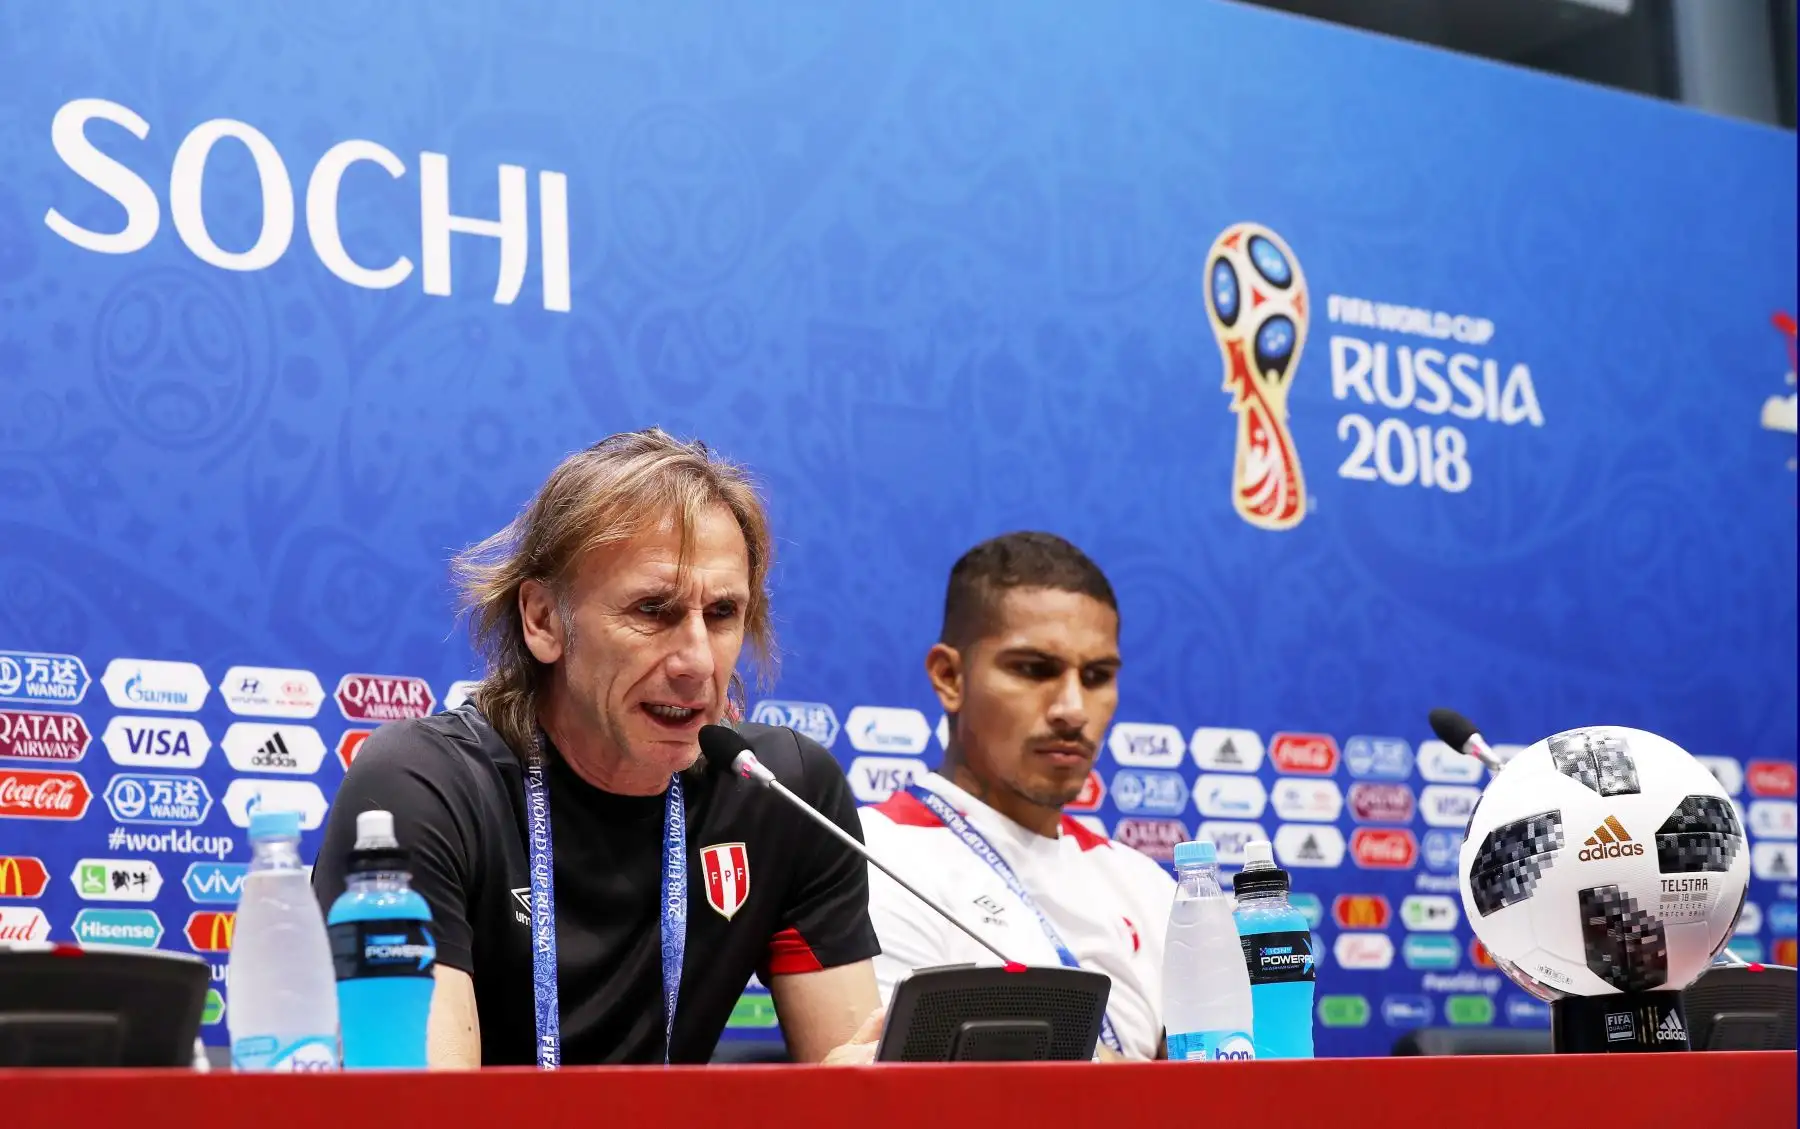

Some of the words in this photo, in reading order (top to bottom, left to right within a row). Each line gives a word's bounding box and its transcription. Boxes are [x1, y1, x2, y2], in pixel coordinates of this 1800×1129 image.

[44, 98, 571, 312] SOCHI
[1329, 335, 1545, 428] RUSSIA
[1336, 413, 1472, 493] 2018
[26, 682, 77, 699] WANDA
[342, 678, 424, 708] QATAR
[363, 703, 424, 719] AIRWAYS
[12, 740, 80, 758] AIRWAYS
[124, 727, 192, 757] VISA
[251, 752, 297, 768] adidas
[150, 804, 199, 820] WANDA
[531, 792, 548, 851] WORLD
[669, 786, 681, 842] WORLD
[108, 828, 234, 860] #worldcup
[1578, 841, 1644, 862] adidas
[535, 855, 549, 889] CUP
[668, 848, 682, 880] FIFA
[193, 869, 247, 893] viv
[1661, 878, 1708, 892] TELSTAR
[667, 882, 682, 918] 2018
[0, 912, 39, 941] ud
[81, 921, 155, 939] Hisense
[536, 891, 551, 953] RUSSIA
[1608, 1014, 1631, 1026] FIFA
[1656, 1028, 1687, 1040] adidas
[542, 1035, 555, 1070] FIFA
